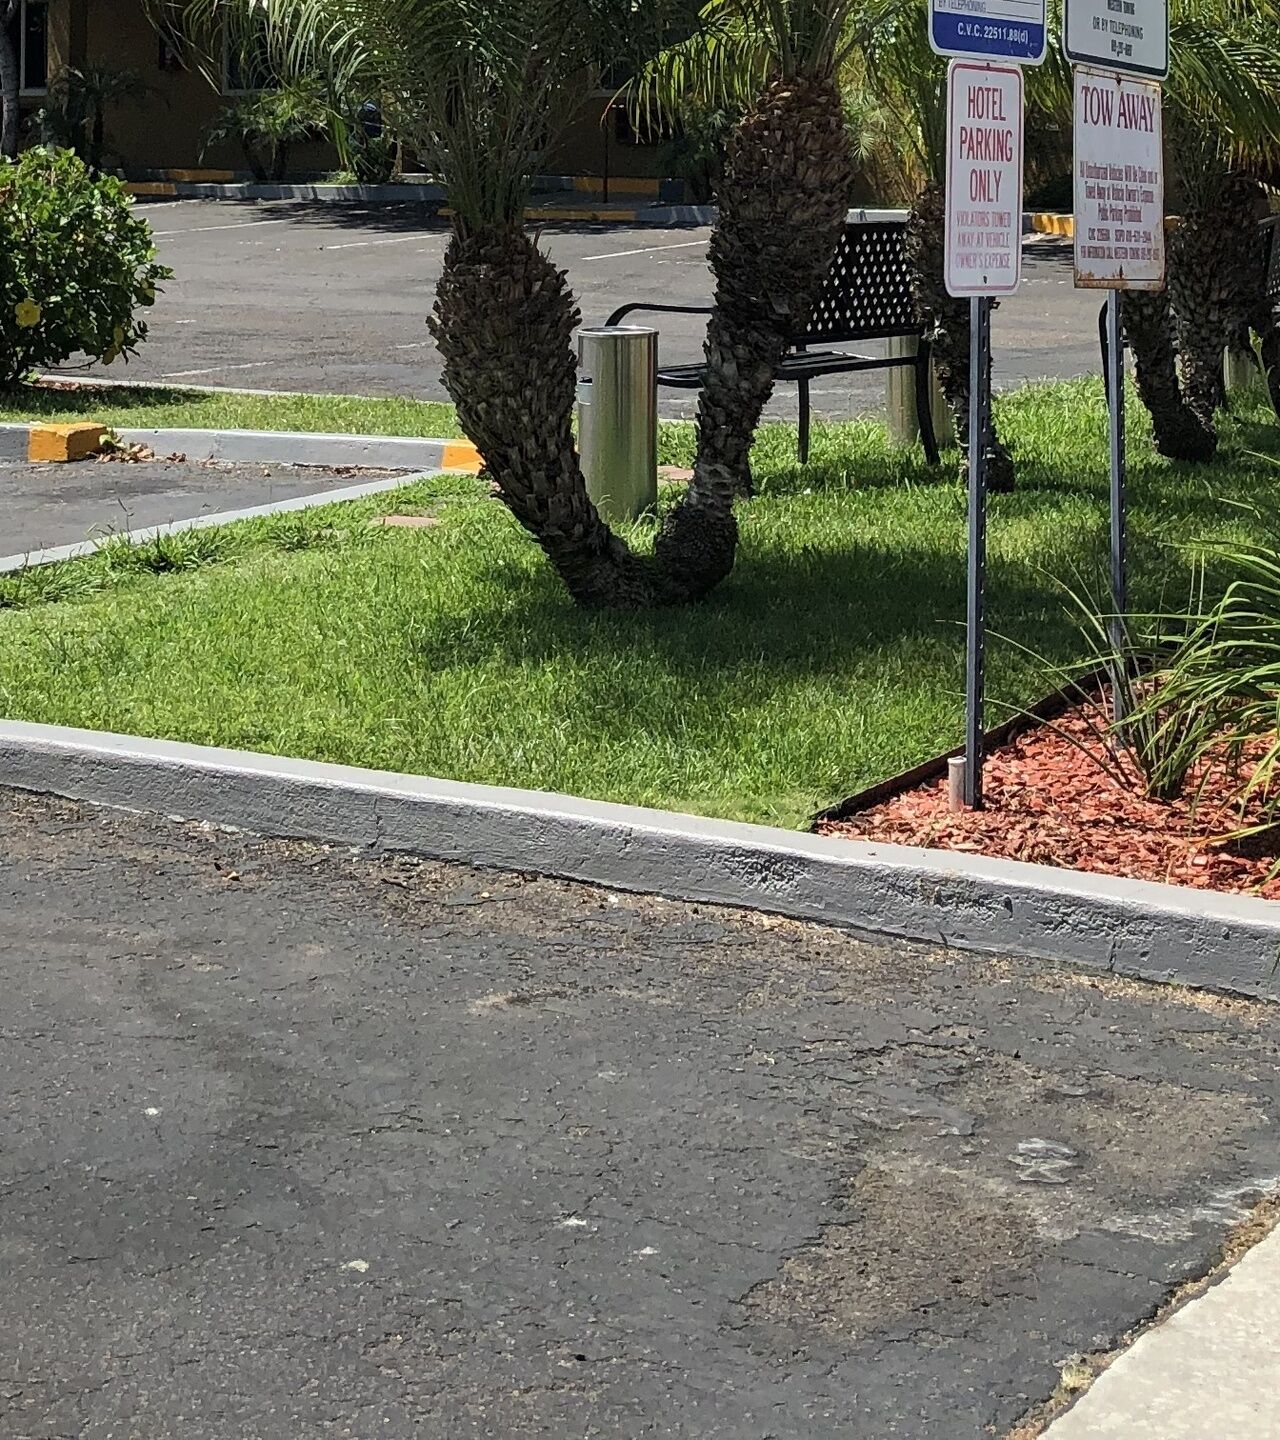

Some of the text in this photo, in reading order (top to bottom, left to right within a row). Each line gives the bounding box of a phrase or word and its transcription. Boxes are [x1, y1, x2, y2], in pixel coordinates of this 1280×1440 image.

[958, 22, 982, 38] C.V.C.
[968, 86, 1006, 122] HOTEL
[1080, 86, 1154, 133] TOW AWAY
[960, 126, 1012, 162] PARKING
[970, 168, 1002, 202] ONLY
[956, 211, 990, 227] VIOLATORS
